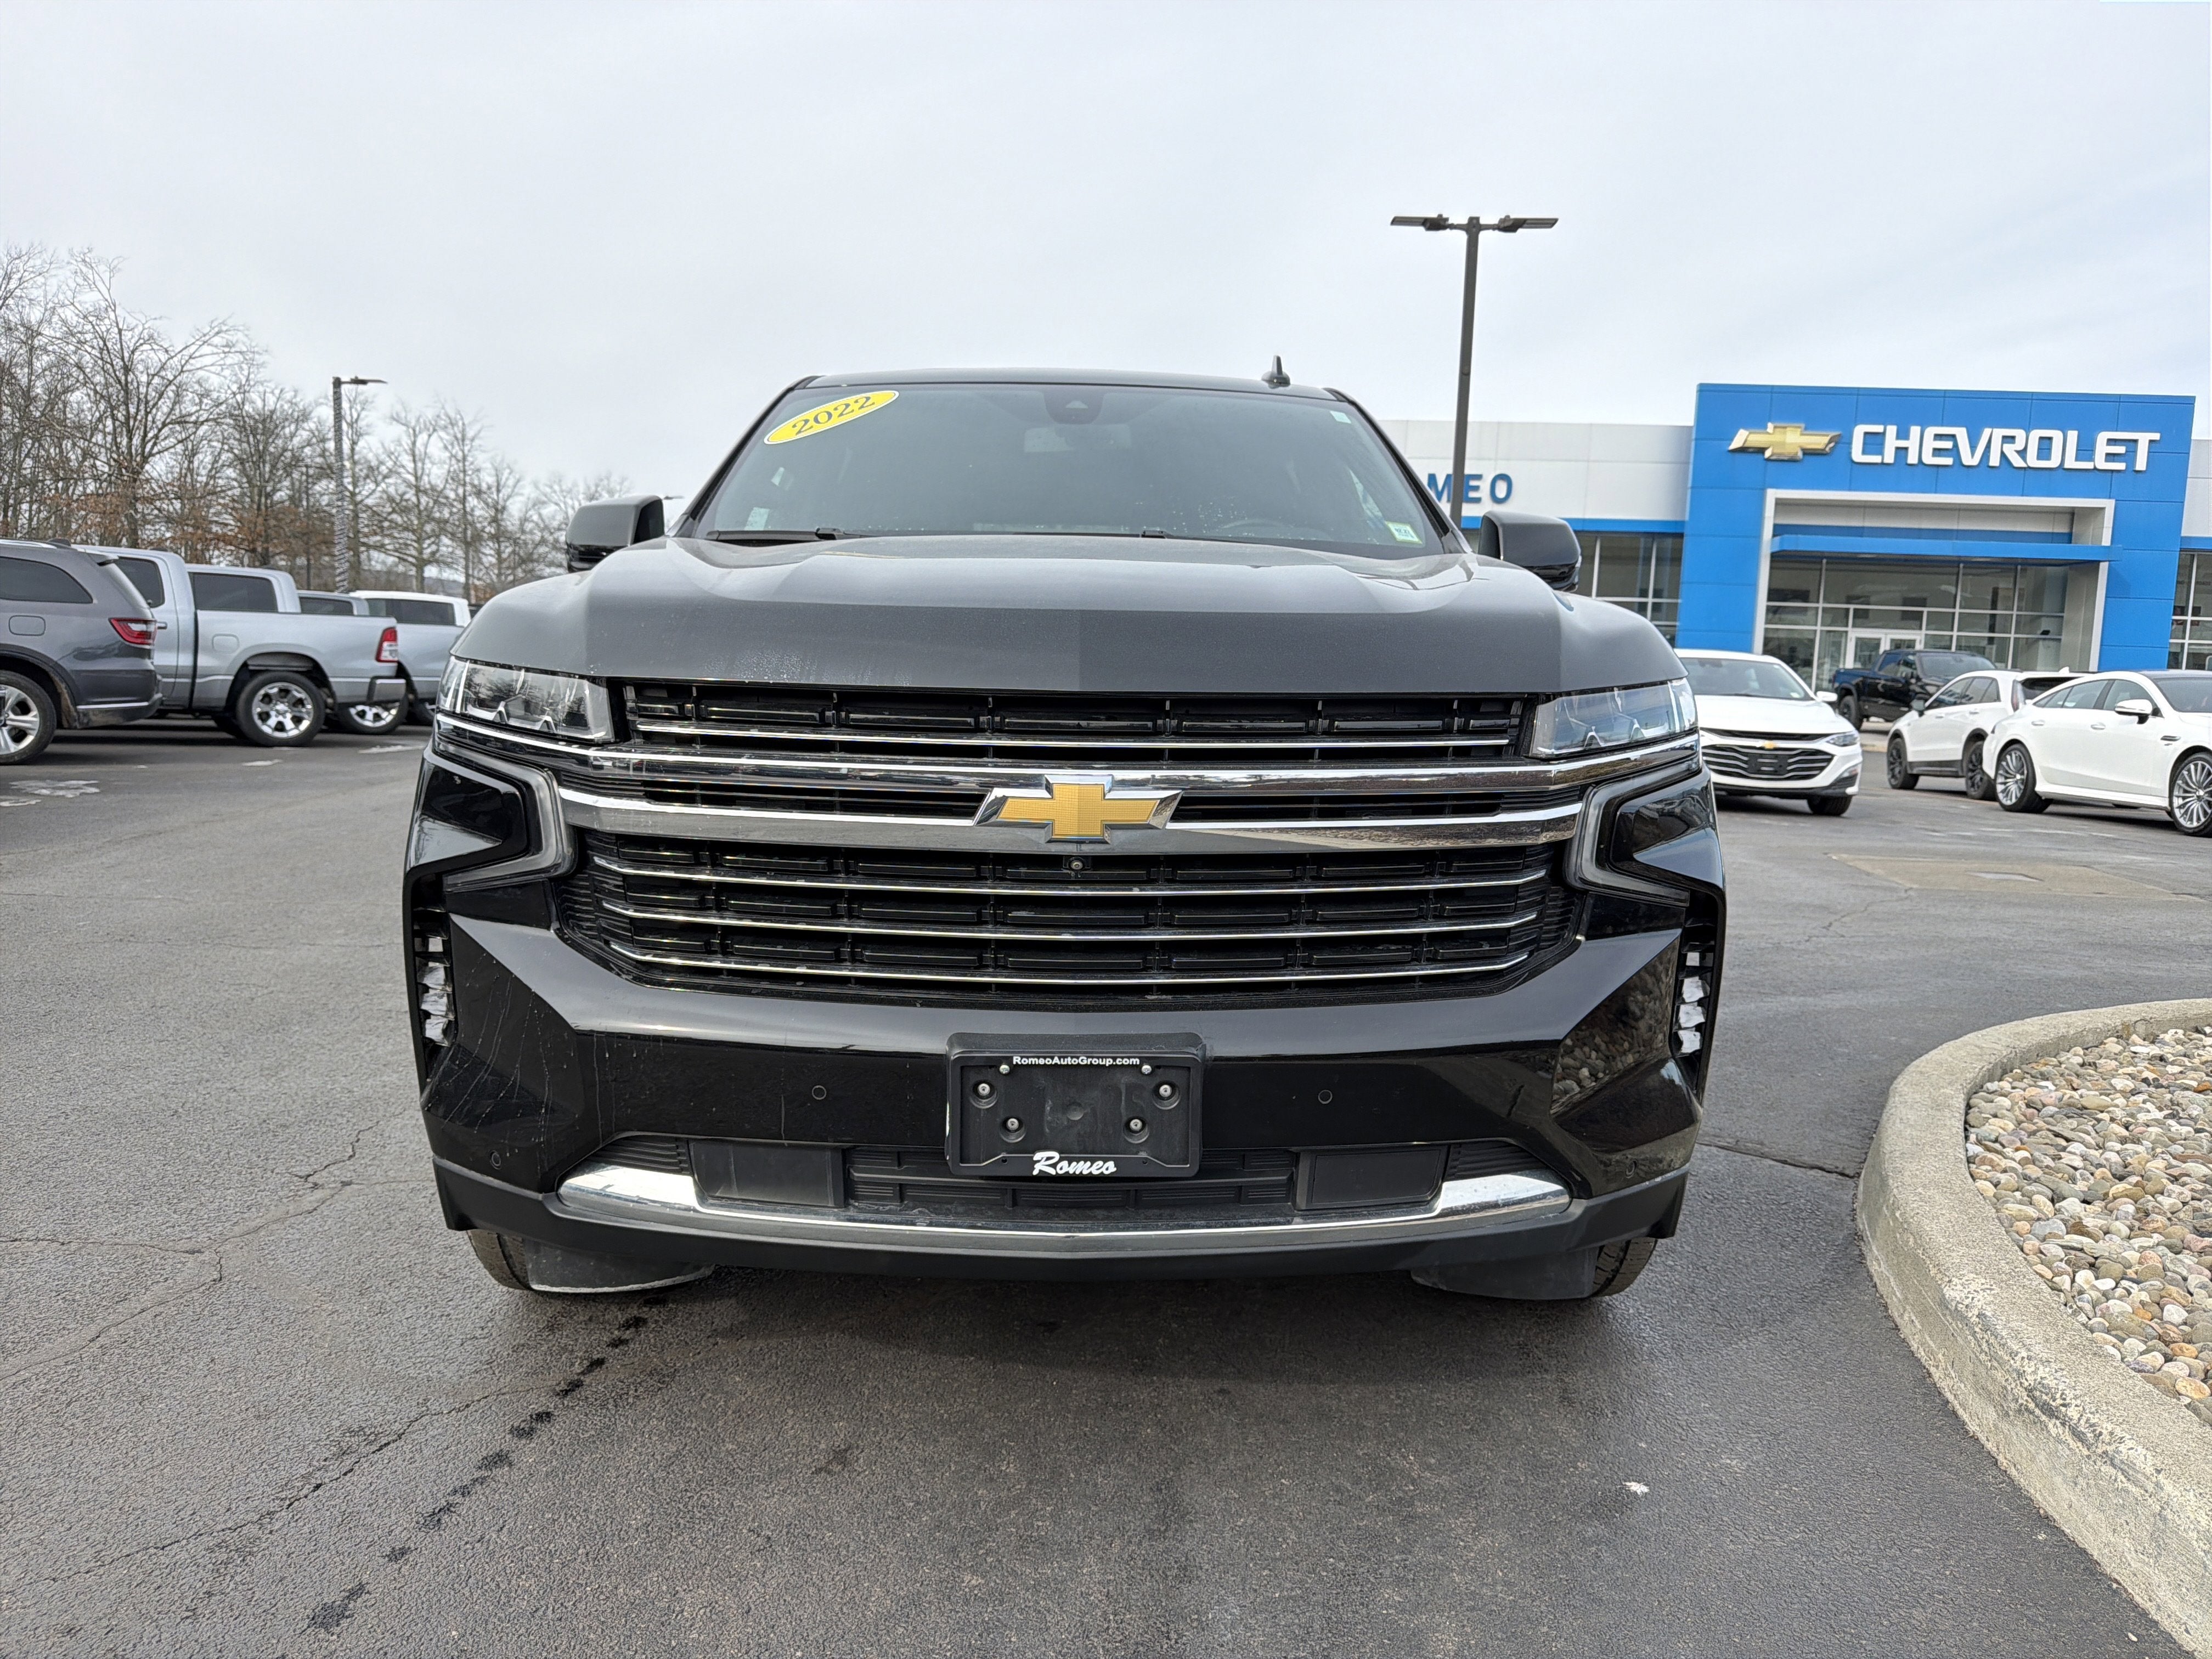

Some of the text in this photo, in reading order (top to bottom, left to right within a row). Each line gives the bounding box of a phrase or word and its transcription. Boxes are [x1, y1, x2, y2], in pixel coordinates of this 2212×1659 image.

[792, 396, 875, 436] 2022
[1851, 424, 2160, 470] CHEVROLET
[1013, 1056, 1140, 1066] RomeoAutoGroup.com
[1032, 1151, 1117, 1175] Romeo
